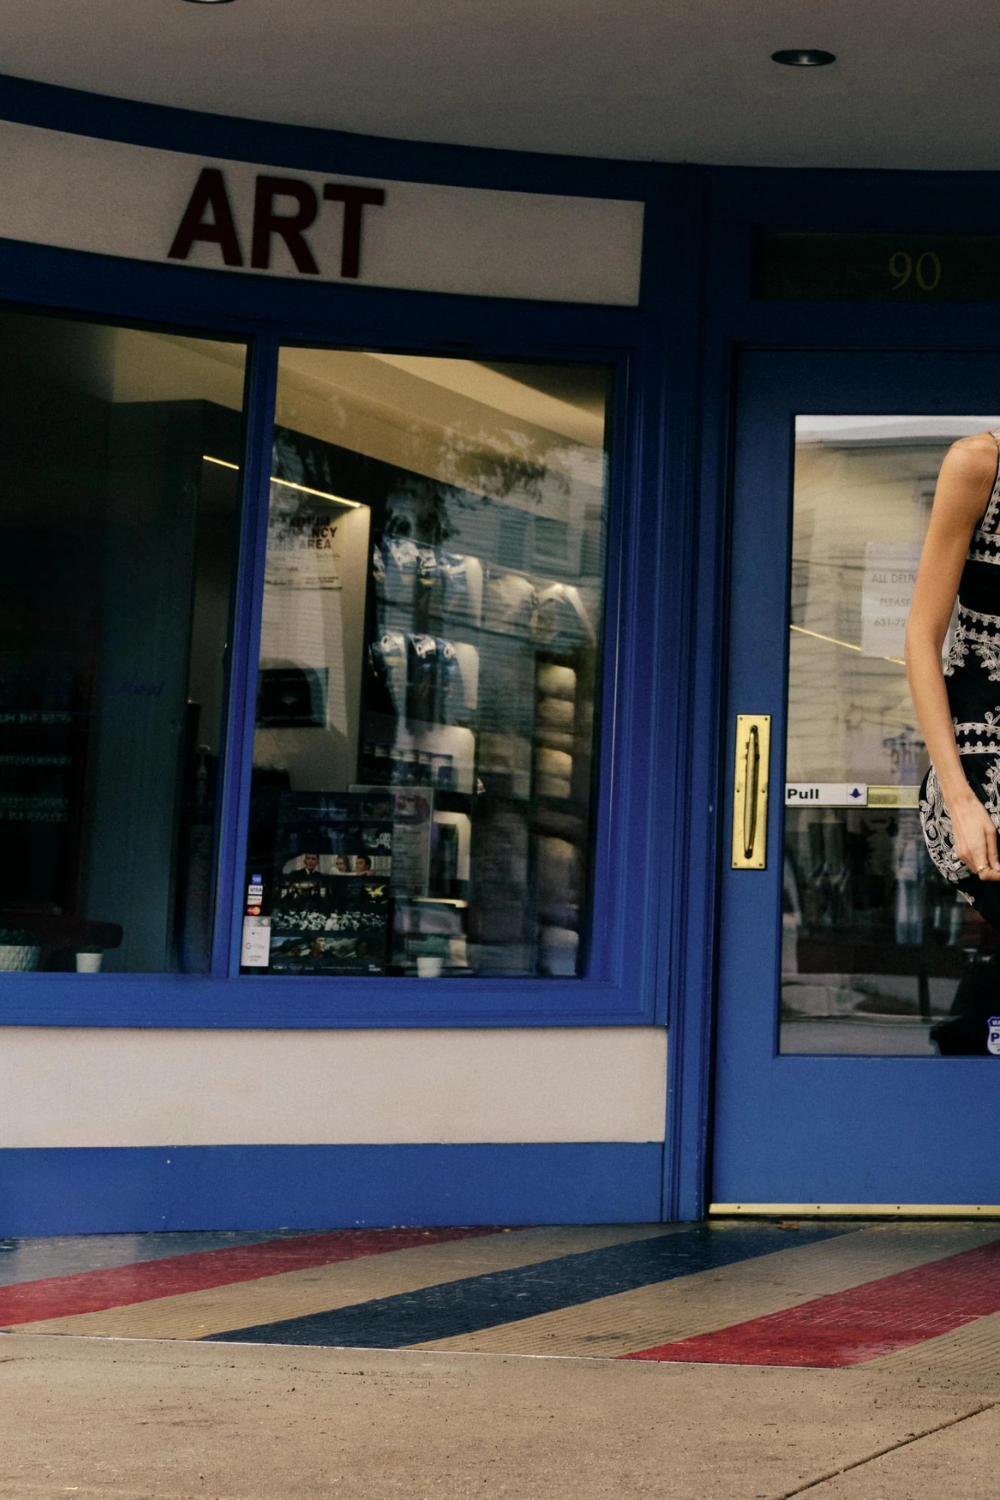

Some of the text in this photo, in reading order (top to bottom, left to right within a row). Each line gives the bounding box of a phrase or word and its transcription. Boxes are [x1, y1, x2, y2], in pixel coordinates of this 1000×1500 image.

[168, 168, 385, 278] ART
[889, 251, 942, 291] 90
[300, 539, 332, 550] AREA
[872, 574, 888, 584] ALL
[787, 788, 819, 799] Pull
